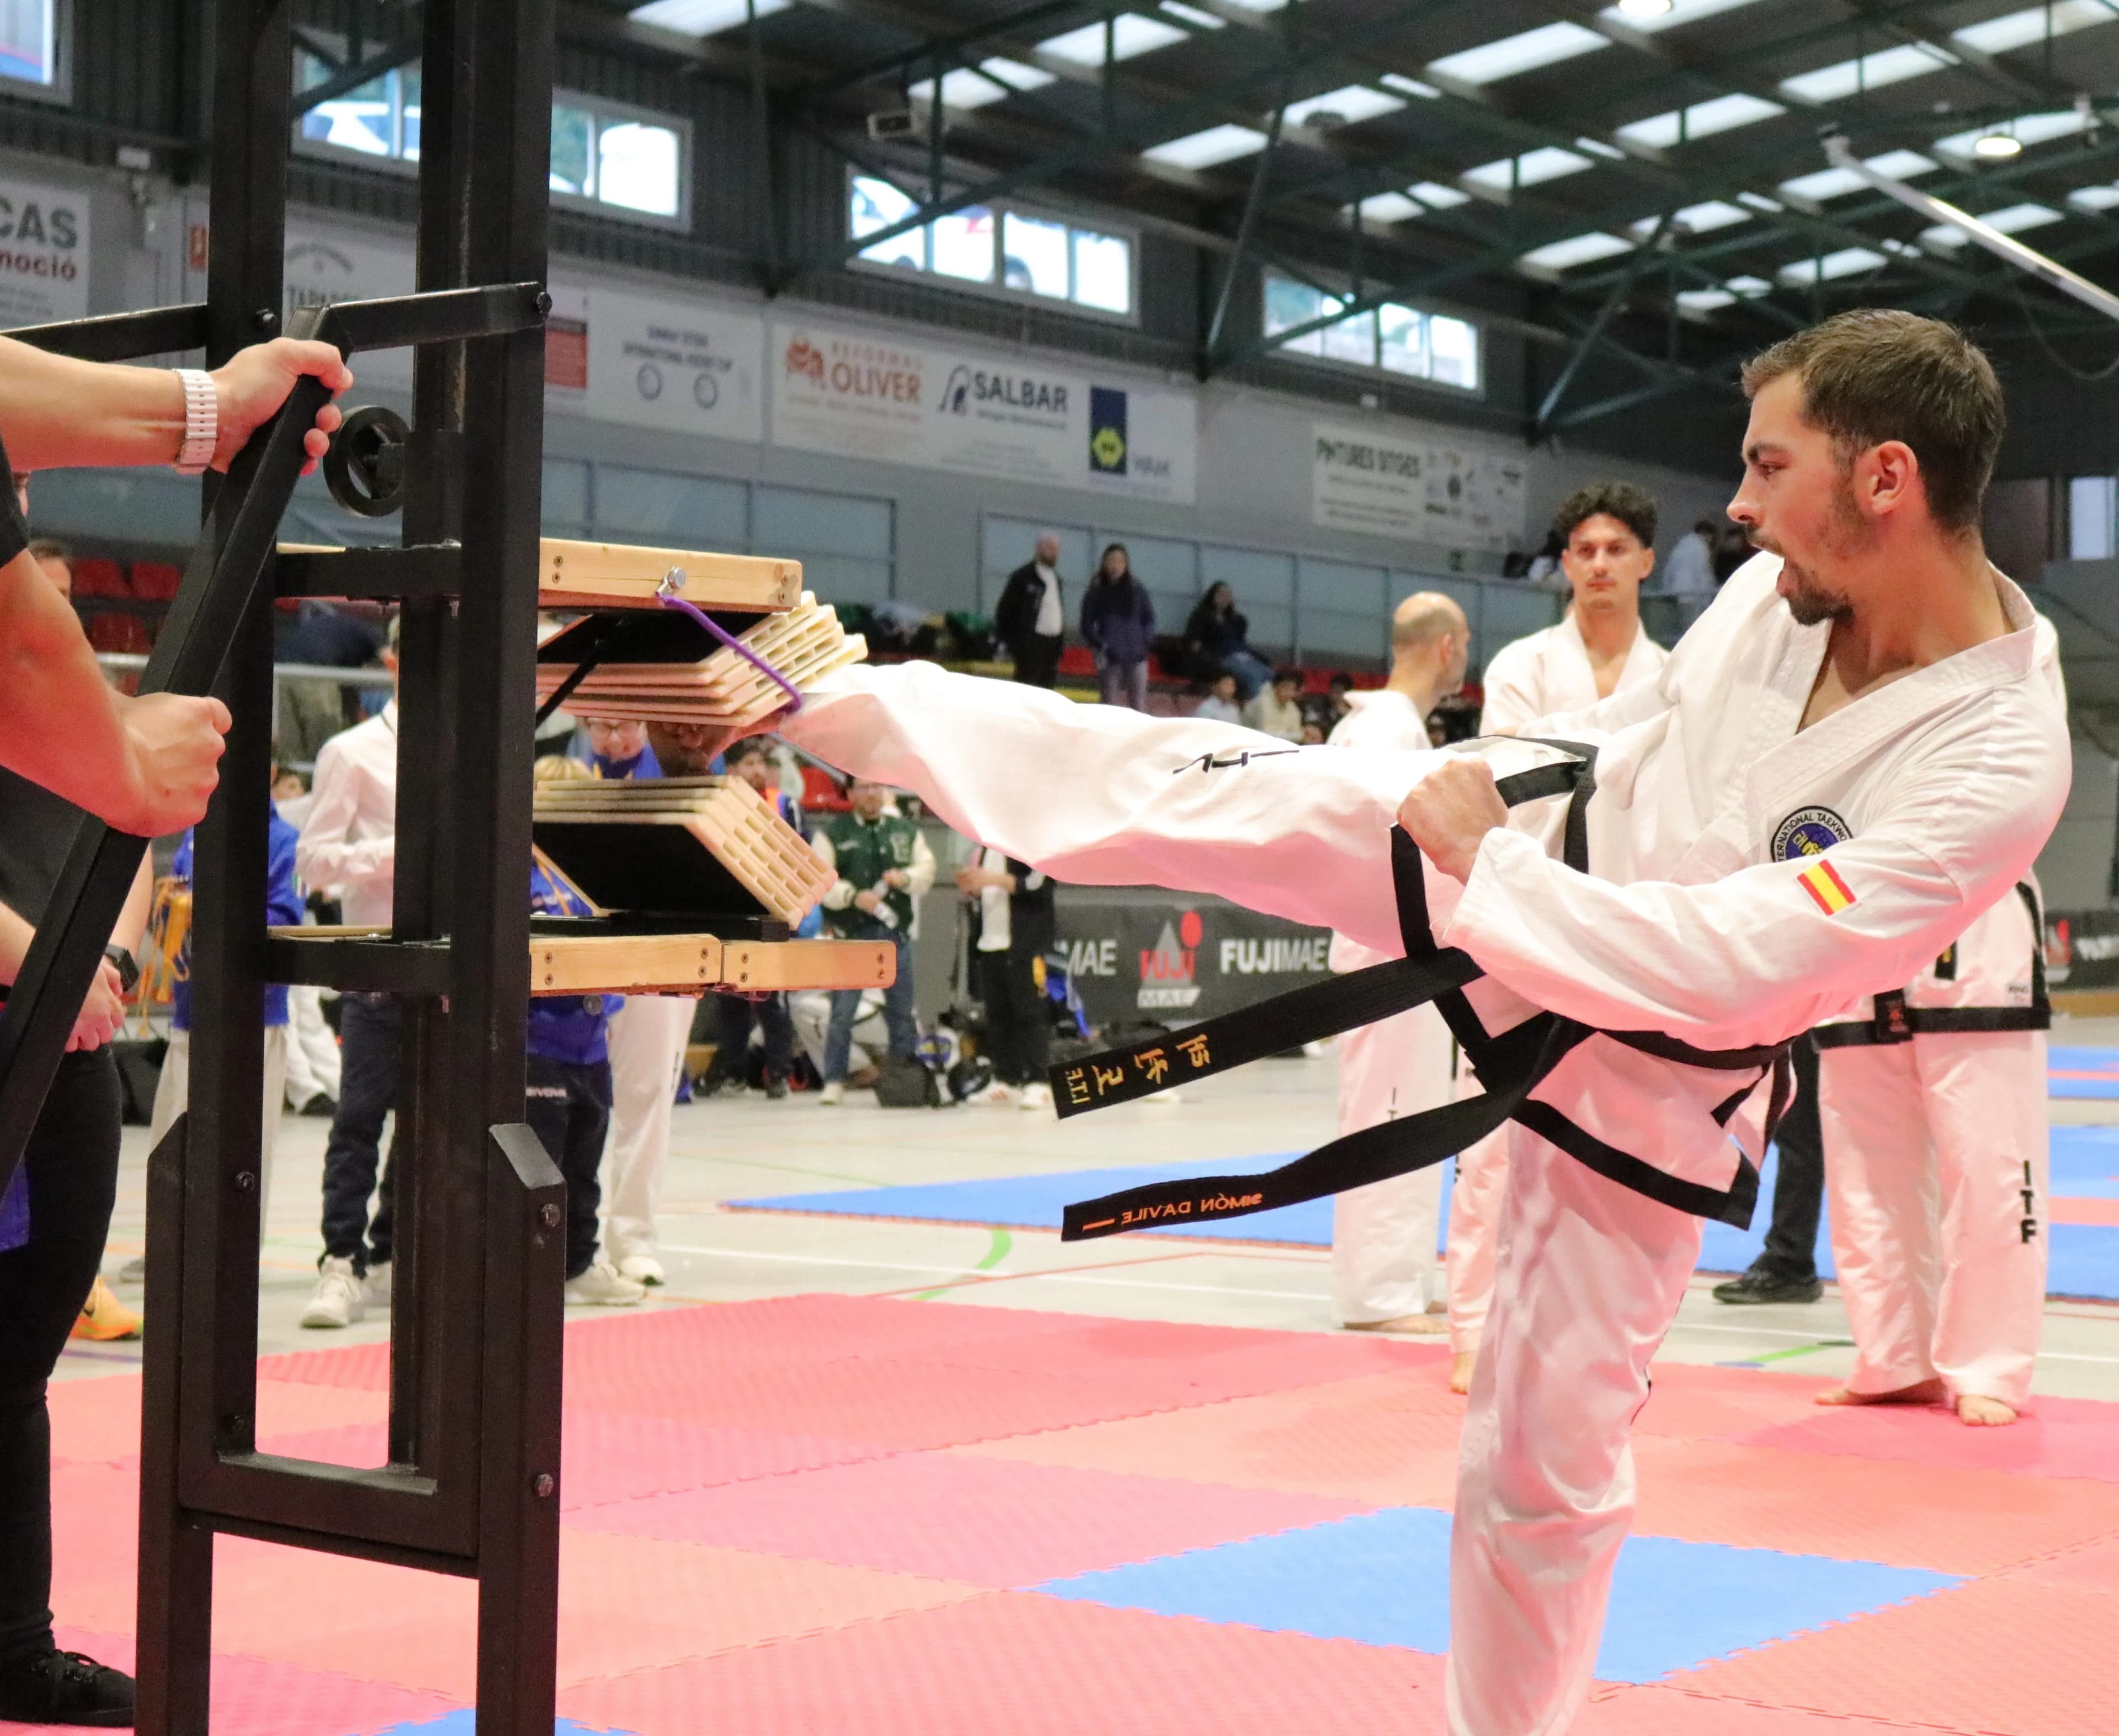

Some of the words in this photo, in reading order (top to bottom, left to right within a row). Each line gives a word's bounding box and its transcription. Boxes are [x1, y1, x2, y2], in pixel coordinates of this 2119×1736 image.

[830, 361, 922, 404] OLIVER
[974, 371, 1068, 413] SALBAR
[1220, 939, 1328, 974] FUJIMAE
[2020, 1160, 2037, 1244] ITF
